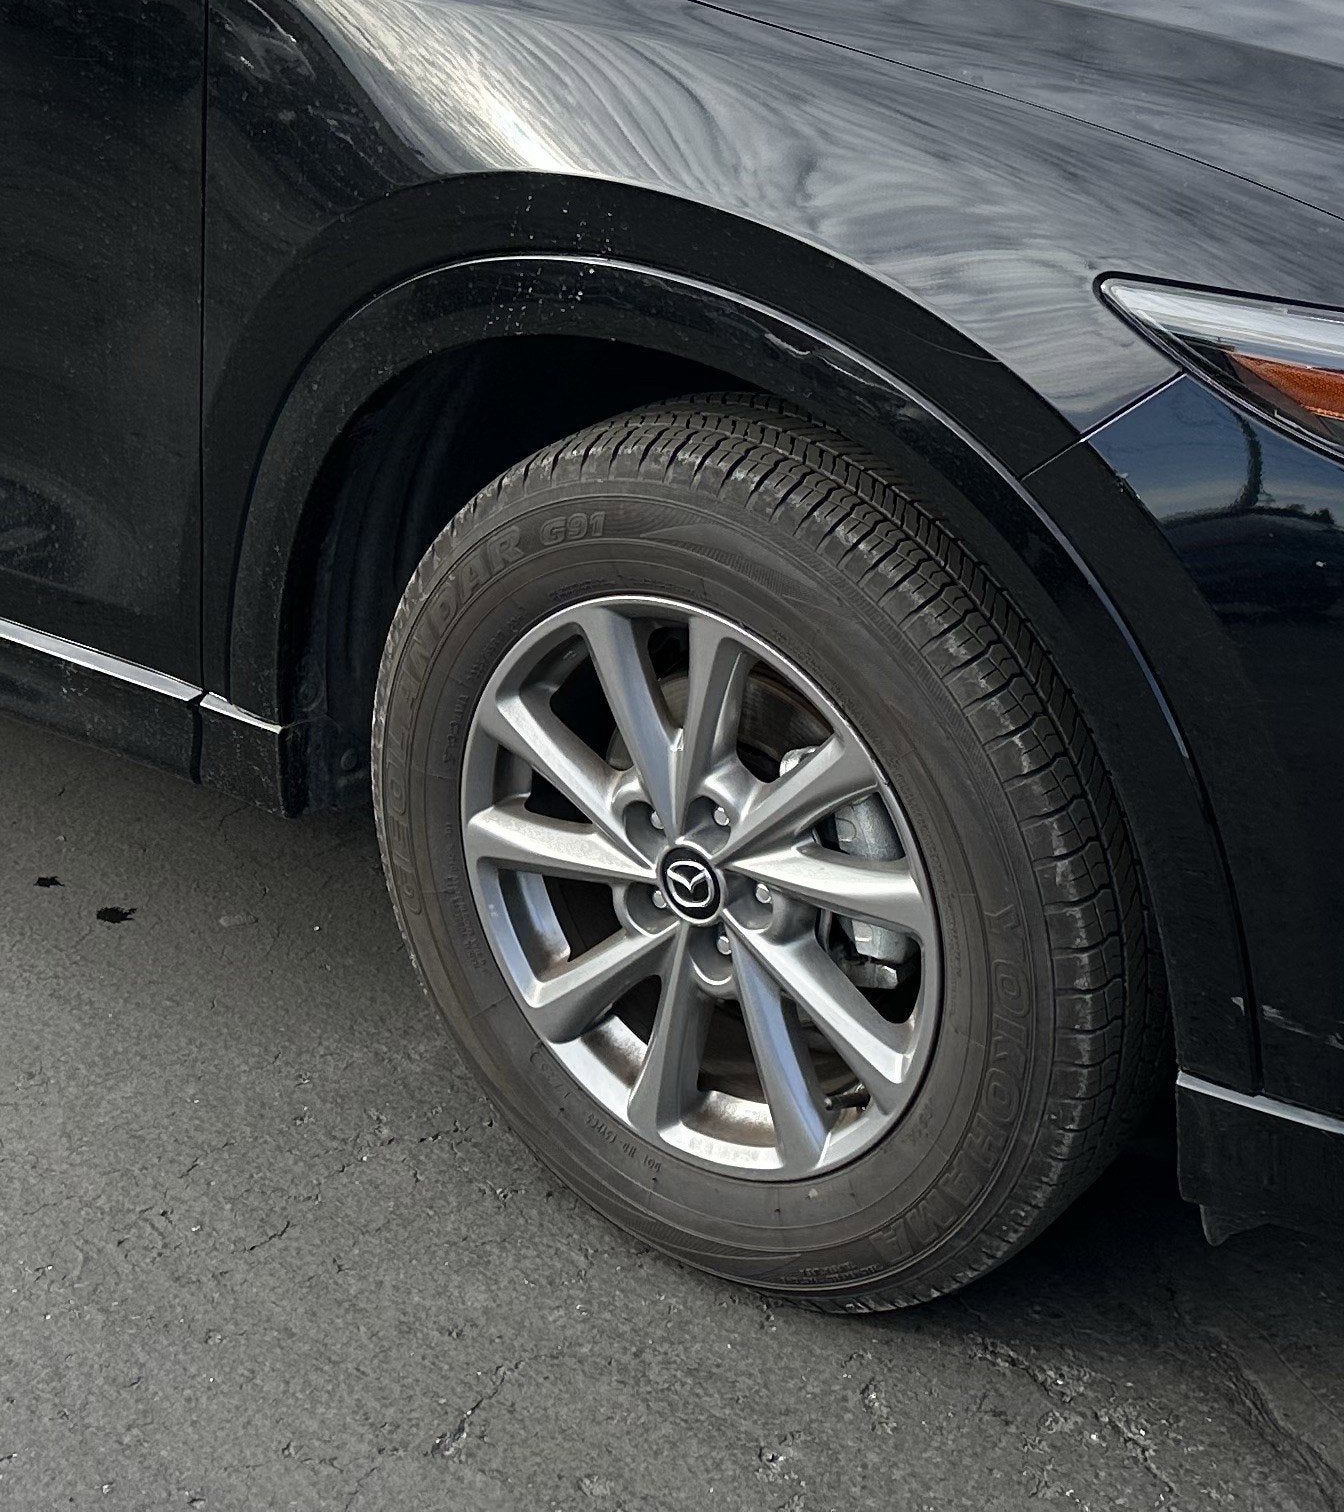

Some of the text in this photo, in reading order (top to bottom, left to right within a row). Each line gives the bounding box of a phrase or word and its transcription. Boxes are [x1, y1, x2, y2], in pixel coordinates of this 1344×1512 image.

[387, 525, 522, 915] GEOLANDAR
[540, 510, 606, 546] G91
[869, 904, 1030, 1264] YOKOHAMA
